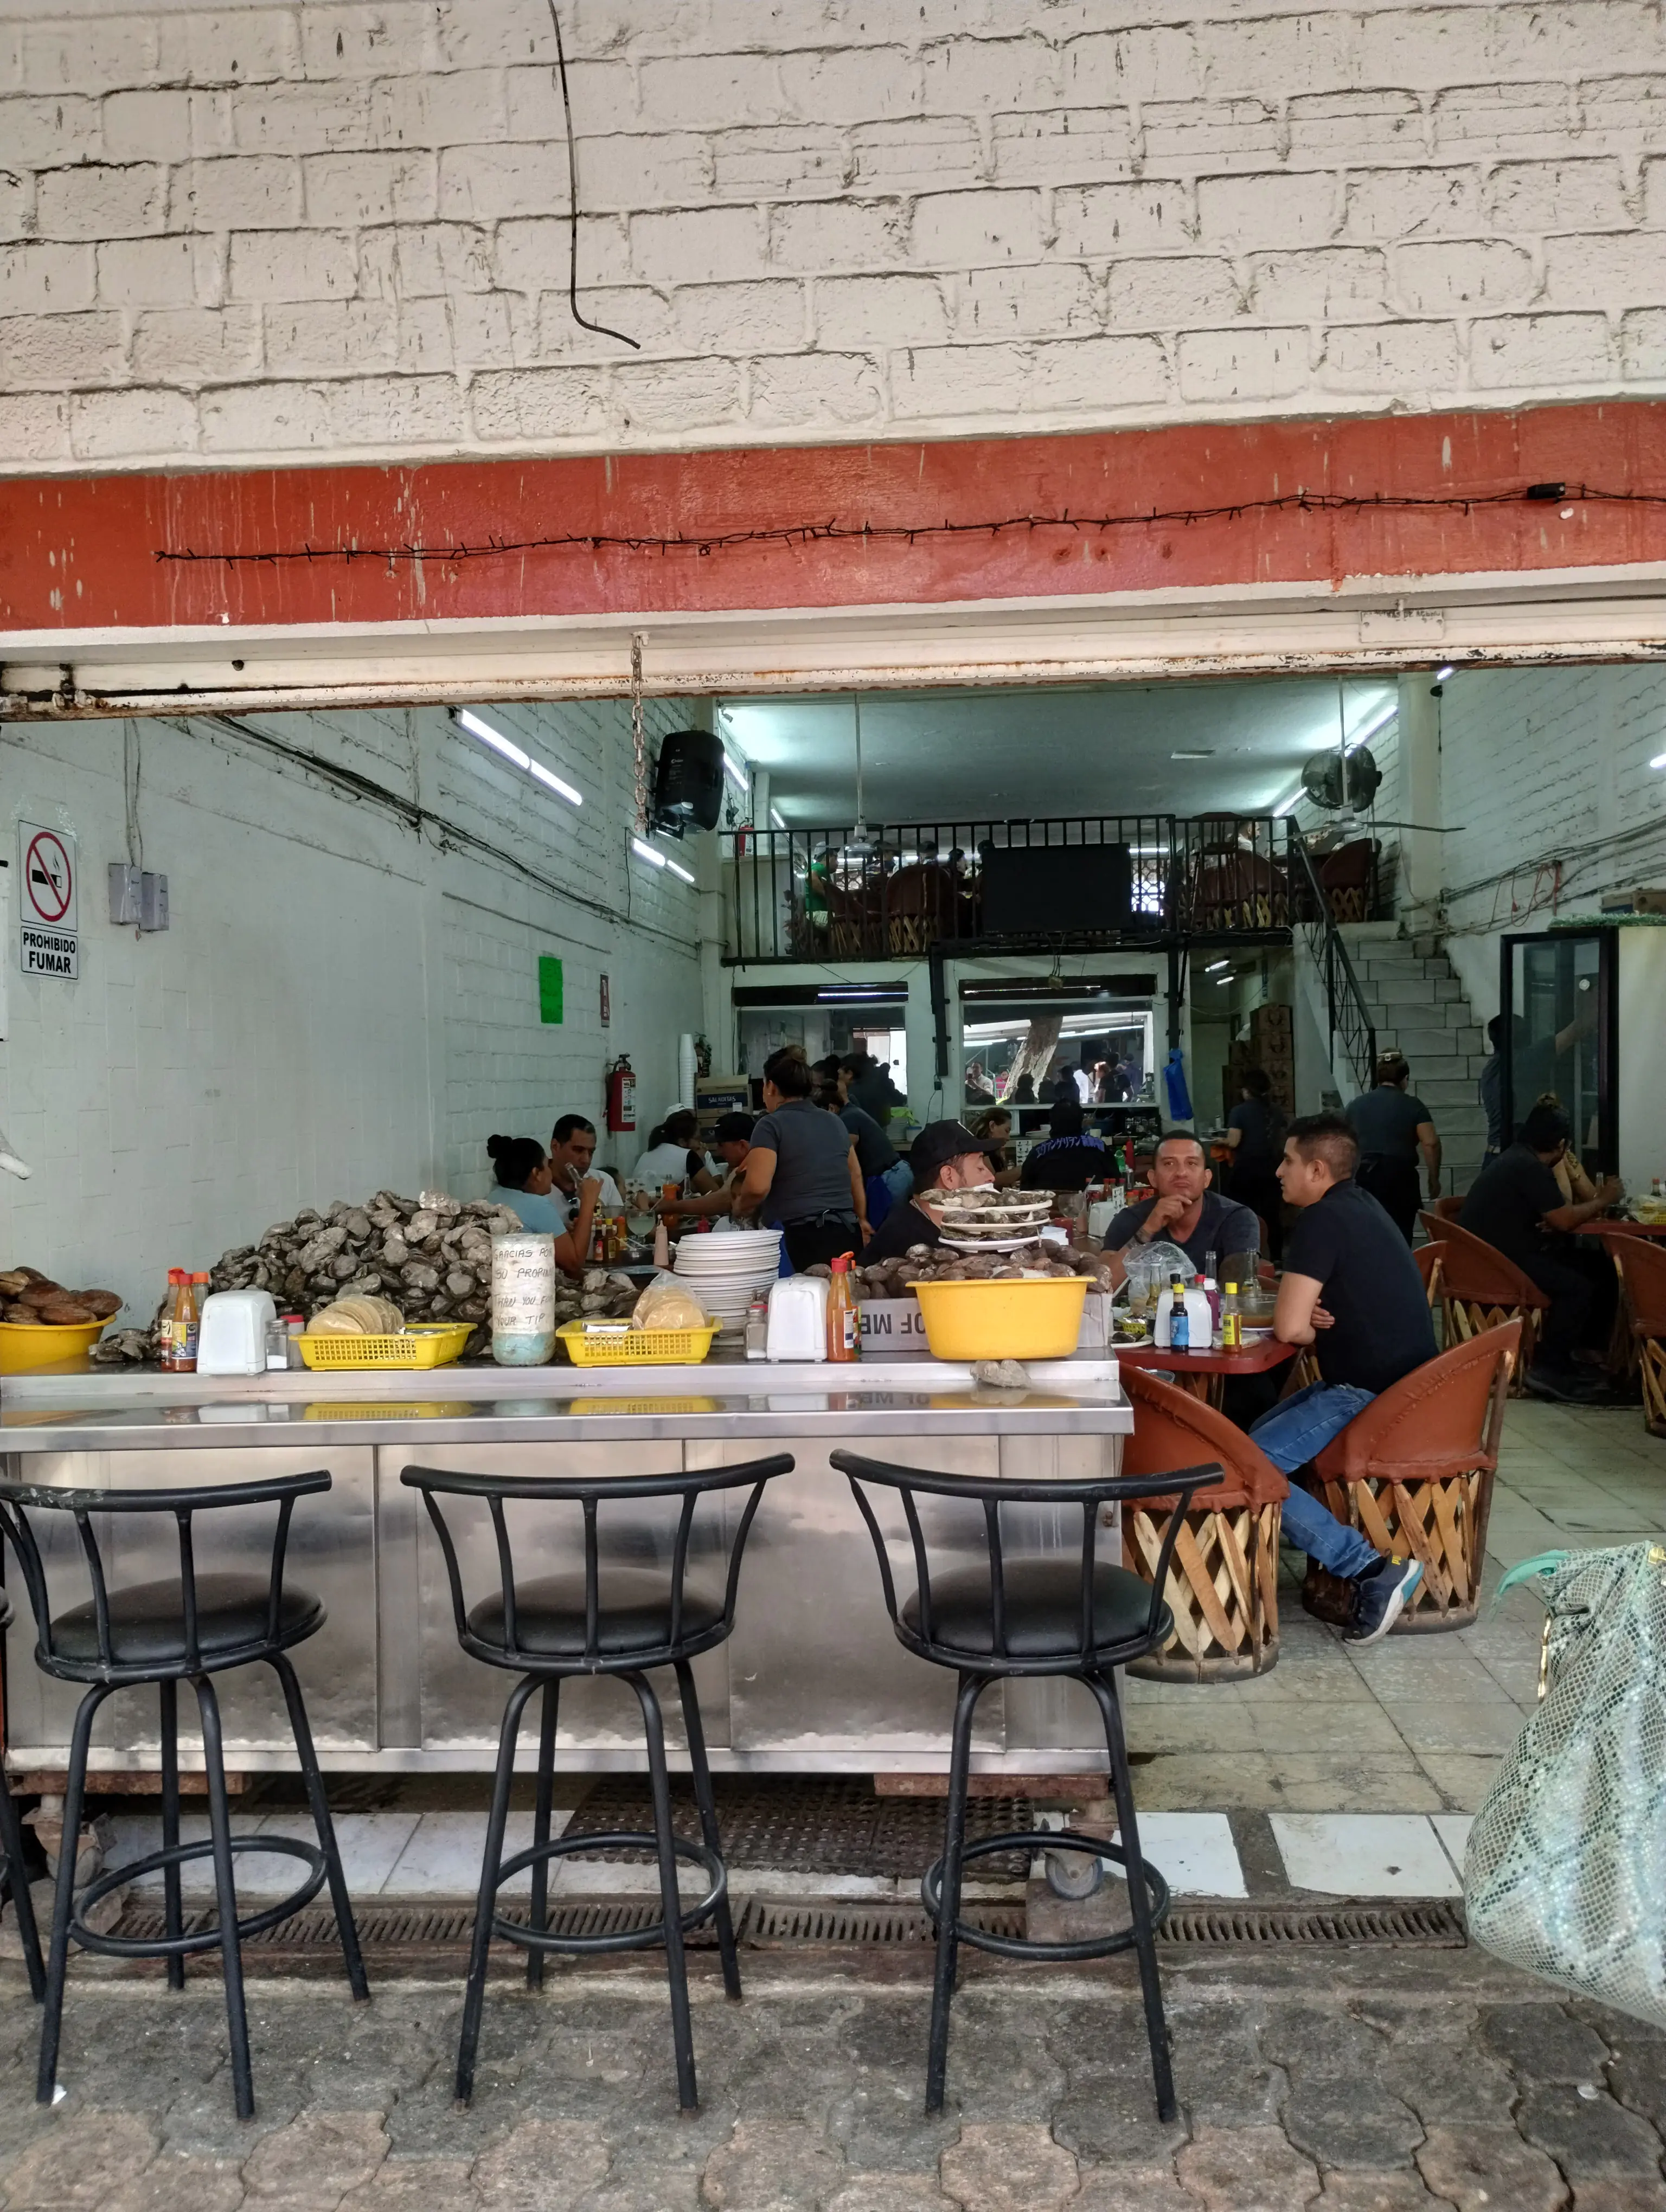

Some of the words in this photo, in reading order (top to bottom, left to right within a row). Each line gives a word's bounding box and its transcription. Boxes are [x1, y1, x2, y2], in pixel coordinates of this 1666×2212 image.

[23, 932, 75, 954] PROHIBIDO
[29, 951, 71, 973] FUMAR
[517, 1266, 554, 1278] PROPIN
[522, 1296, 536, 1306] YOU
[496, 1314, 516, 1326] YOUR
[526, 1313, 545, 1324] TIP
